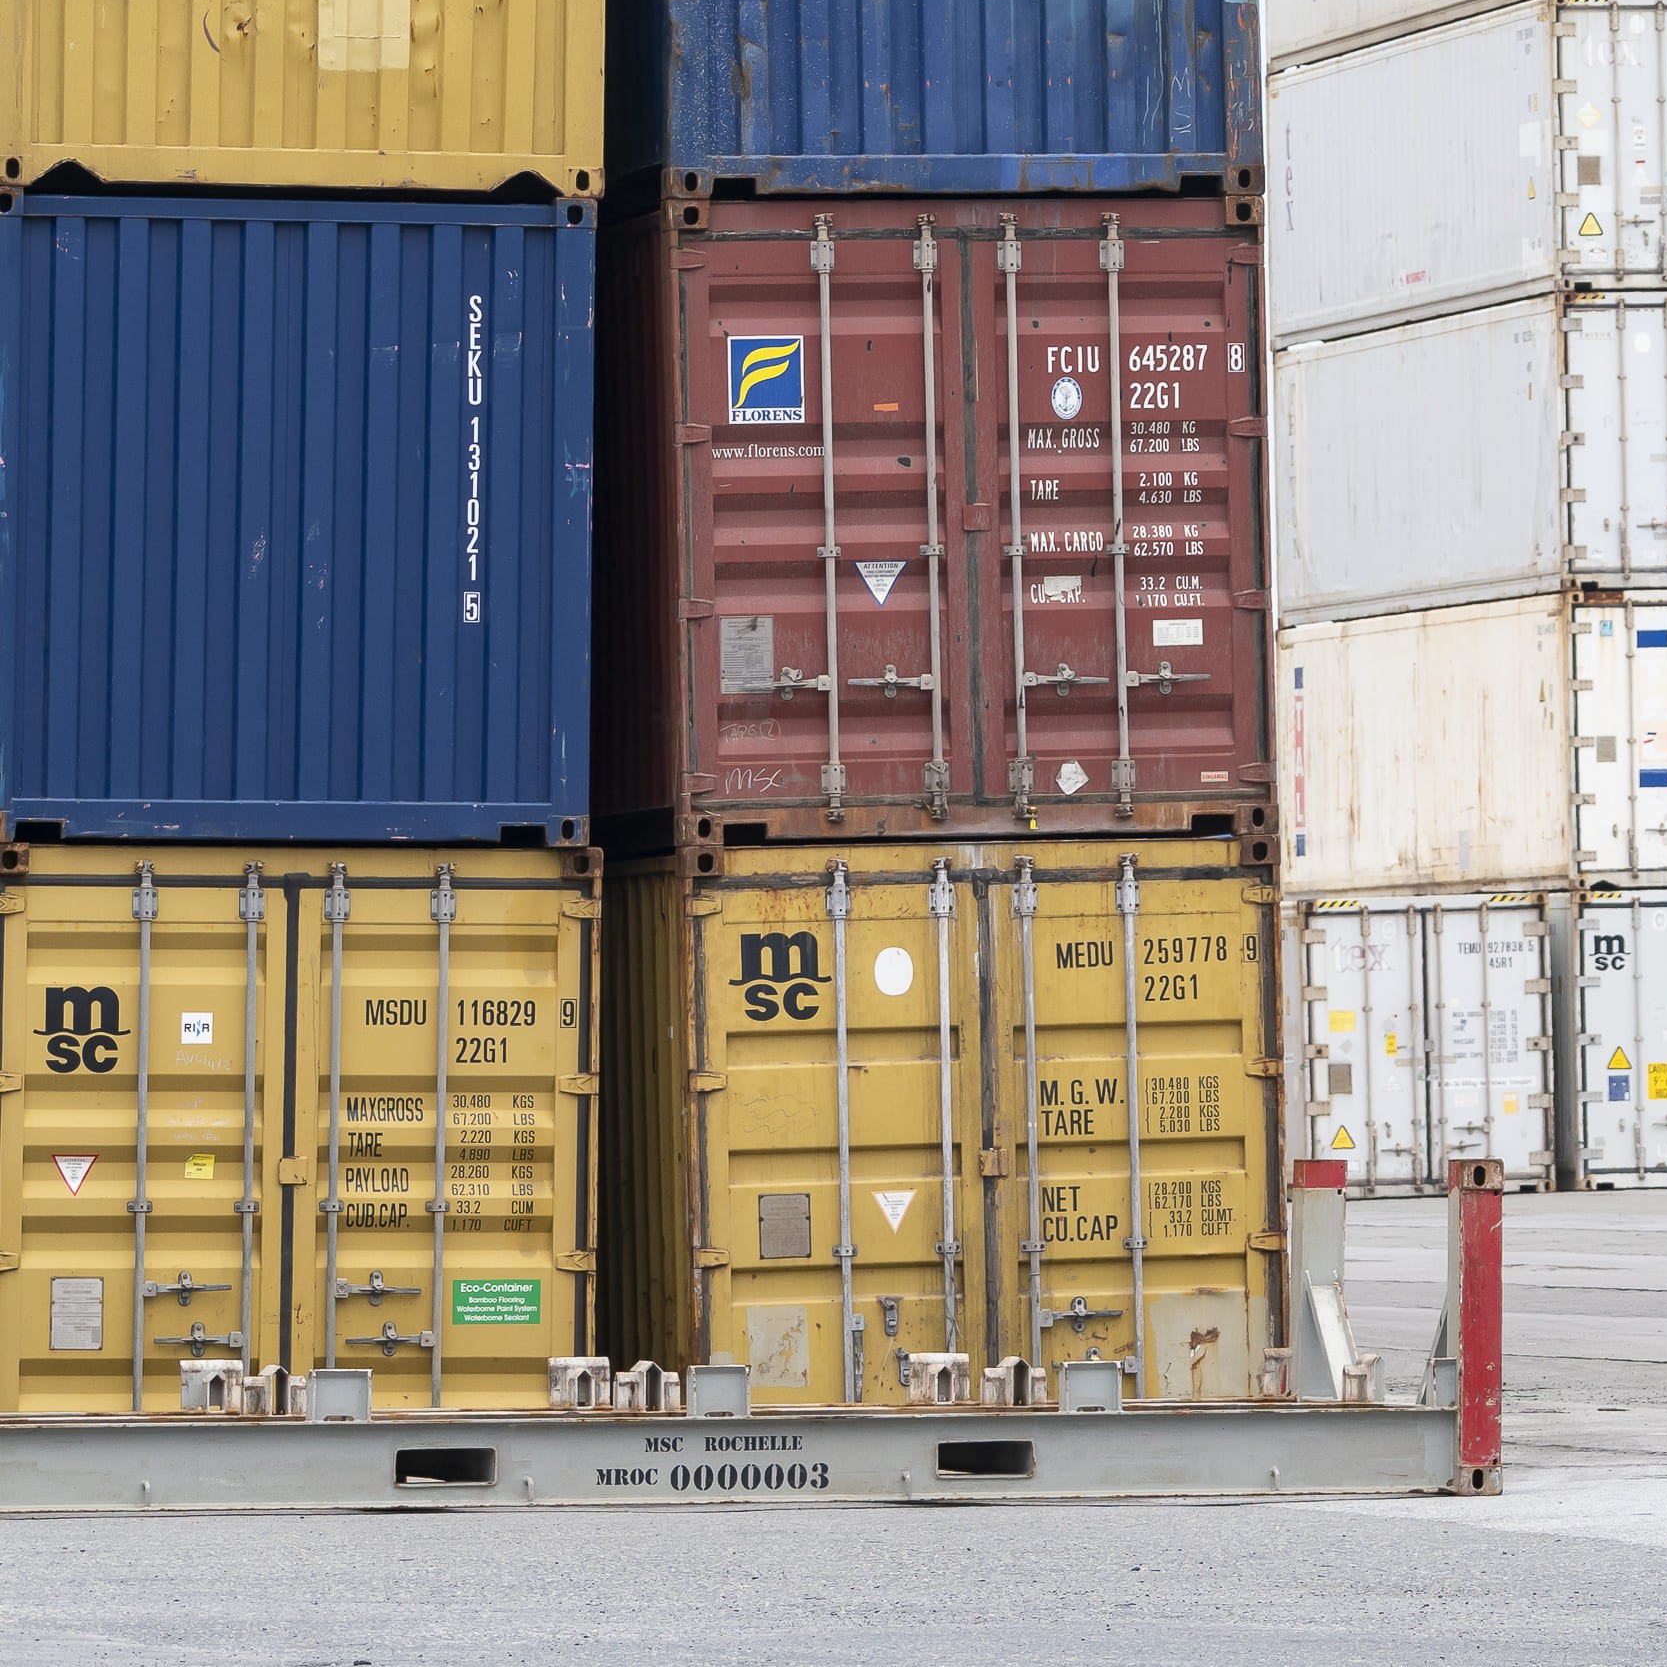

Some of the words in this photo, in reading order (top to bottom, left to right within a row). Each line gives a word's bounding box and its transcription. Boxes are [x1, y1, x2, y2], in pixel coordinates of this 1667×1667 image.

[467, 295, 483, 406] SEKU
[1047, 345, 1100, 374] FCIU
[1128, 343, 1208, 372] 645287
[1229, 344, 1243, 370] 8
[1129, 382, 1181, 410] 22G1
[731, 408, 803, 423] FLORENS
[1182, 420, 1196, 434] KG
[711, 443, 825, 459] www.florens.com
[1027, 428, 1058, 450] MAX.
[1061, 428, 1100, 448] GROSS
[1181, 437, 1200, 452] LBS
[1030, 479, 1060, 501] TARE
[1183, 472, 1199, 487] KG
[465, 417, 481, 581] 131021
[1030, 531, 1061, 553] MAX.
[1065, 531, 1104, 553] CARGO
[464, 593, 479, 621] 5
[1056, 939, 1113, 970] MEDU
[1143, 936, 1228, 965] 259778
[1245, 936, 1259, 962] 9
[1458, 942, 1481, 955] TEMU
[1488, 941, 1524, 954] 927838
[1144, 974, 1199, 1002] 22G1
[364, 999, 428, 1026] MSDU
[457, 999, 537, 1027] 116829
[561, 1000, 576, 1027] 9
[455, 1037, 509, 1064] 22G1
[346, 1096, 424, 1123] MAXGROSS
[1041, 1109, 1095, 1136] TARE
[348, 1132, 383, 1158] TARE
[345, 1167, 410, 1193] PAYLOAD
[1042, 1185, 1080, 1212] NET
[345, 1203, 411, 1229] CUB.CAP.
[1042, 1215, 1119, 1243] CU.CAP
[459, 1282, 534, 1293] Eco-Container
[644, 1436, 684, 1453] MSC
[704, 1435, 803, 1452] ROCHELLE
[596, 1467, 658, 1487] MROC
[669, 1462, 830, 1492] 0000003
